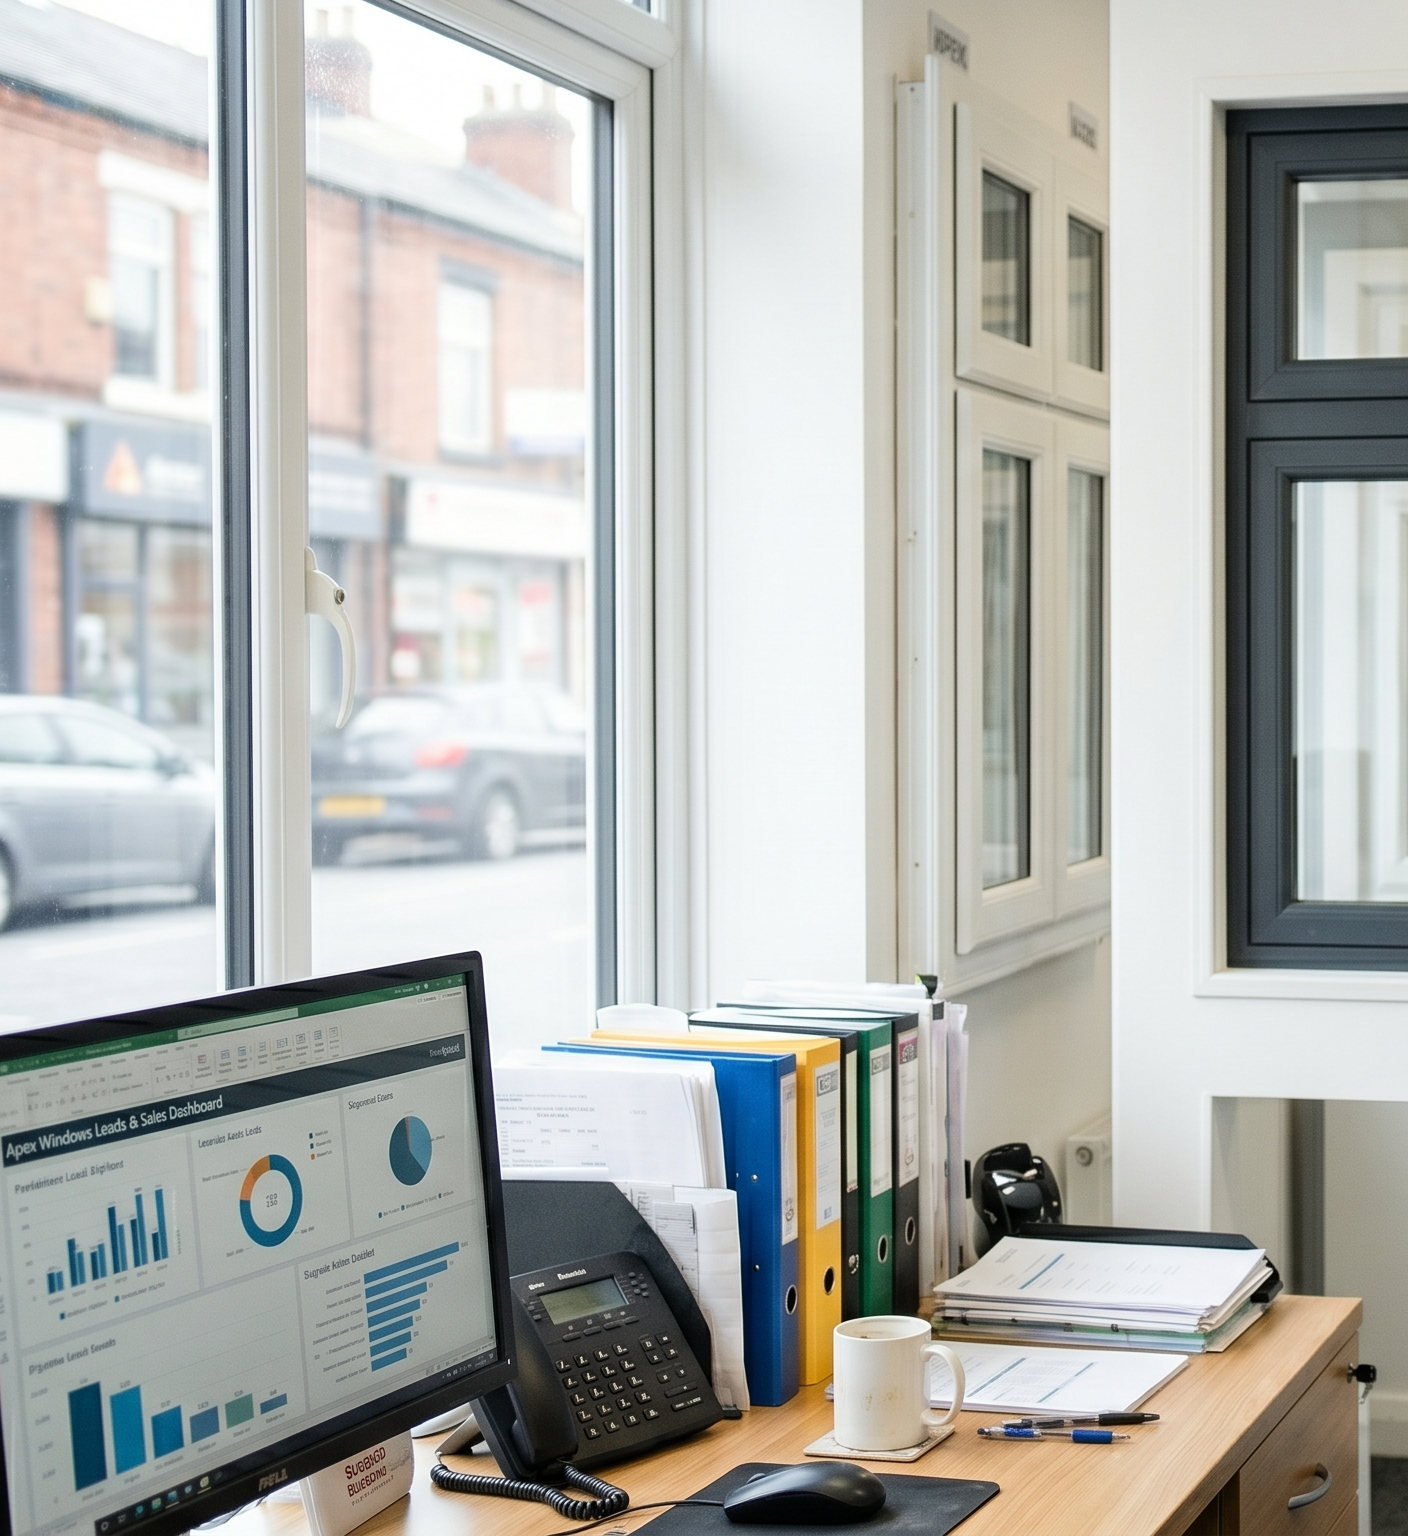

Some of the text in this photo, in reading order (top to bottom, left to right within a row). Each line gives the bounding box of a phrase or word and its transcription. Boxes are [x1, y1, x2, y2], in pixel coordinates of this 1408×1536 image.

[6, 1095, 223, 1162] Apex Windows Leads & Sales Dashboard
